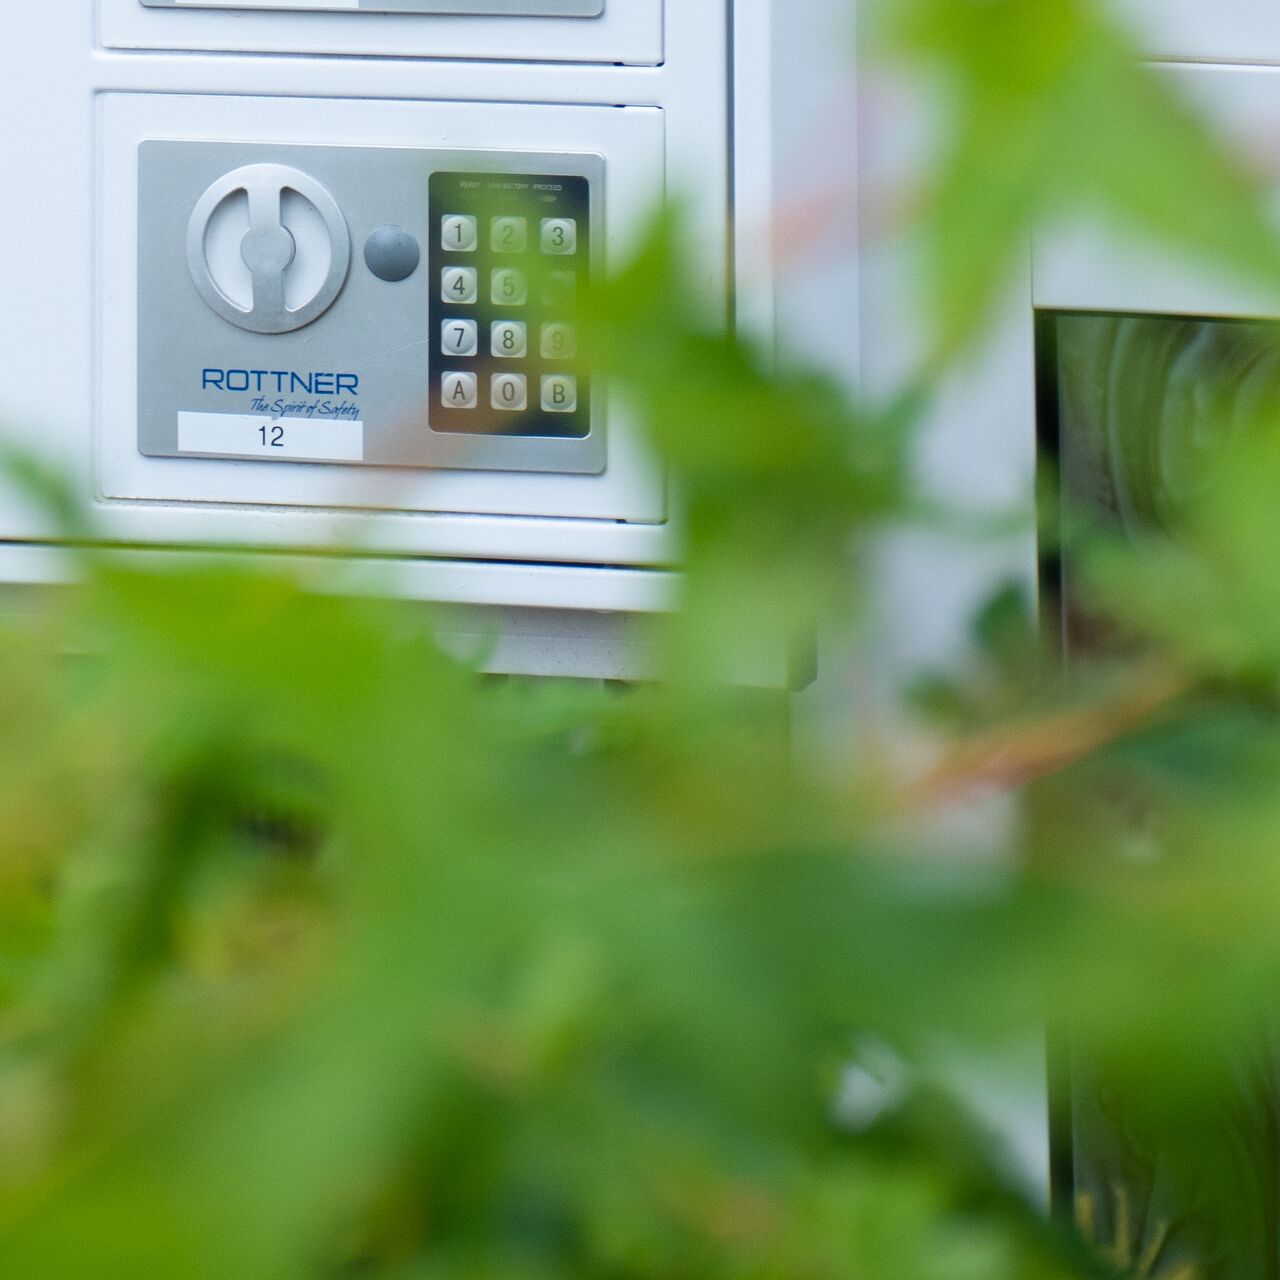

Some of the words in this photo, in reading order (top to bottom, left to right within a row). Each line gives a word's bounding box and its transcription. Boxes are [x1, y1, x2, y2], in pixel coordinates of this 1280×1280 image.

[203, 369, 358, 395] ROTTNER
[250, 395, 268, 412] The
[270, 399, 307, 417] Spirit
[306, 399, 320, 418] of
[318, 400, 359, 421] Safety
[258, 426, 284, 446] 12
